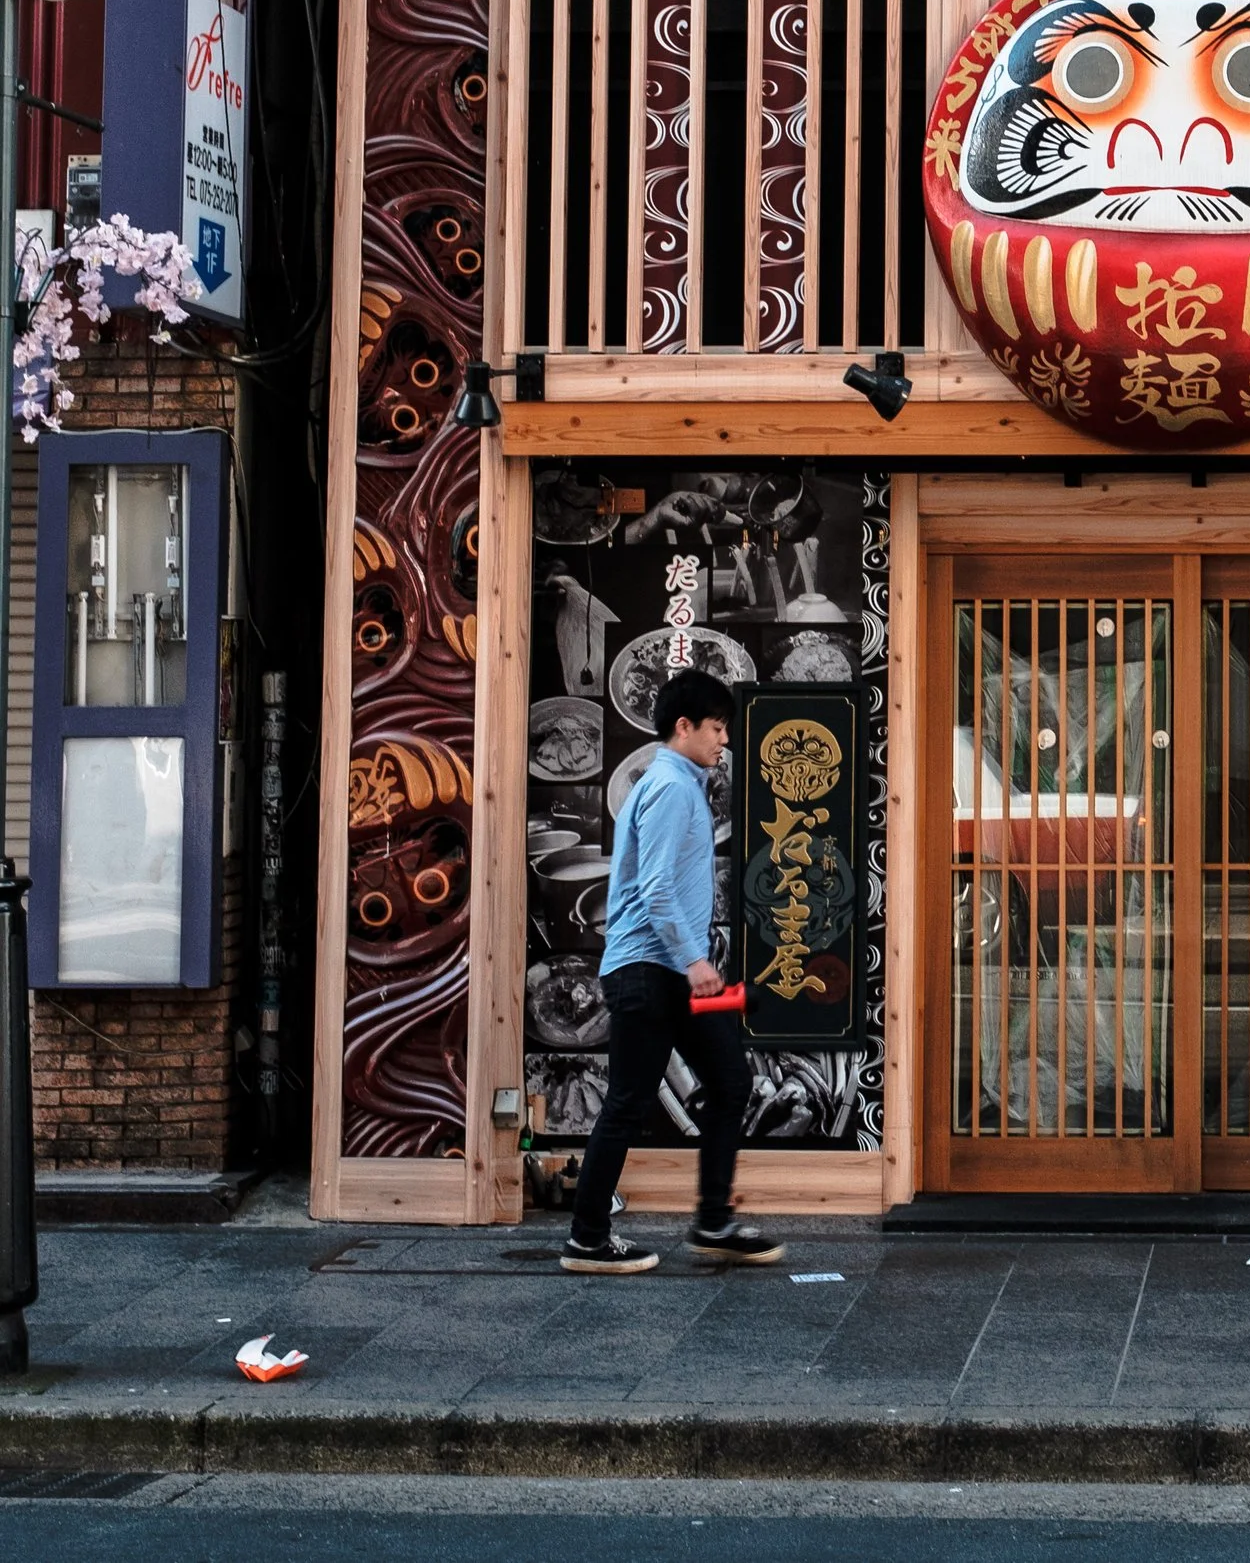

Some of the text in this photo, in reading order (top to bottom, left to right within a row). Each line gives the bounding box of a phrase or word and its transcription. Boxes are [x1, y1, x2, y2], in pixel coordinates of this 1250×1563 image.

[186, 174, 198, 202] TEL
[202, 228, 221, 250] 地下
[205, 251, 218, 275] 1F
[665, 554, 700, 681] だるま
